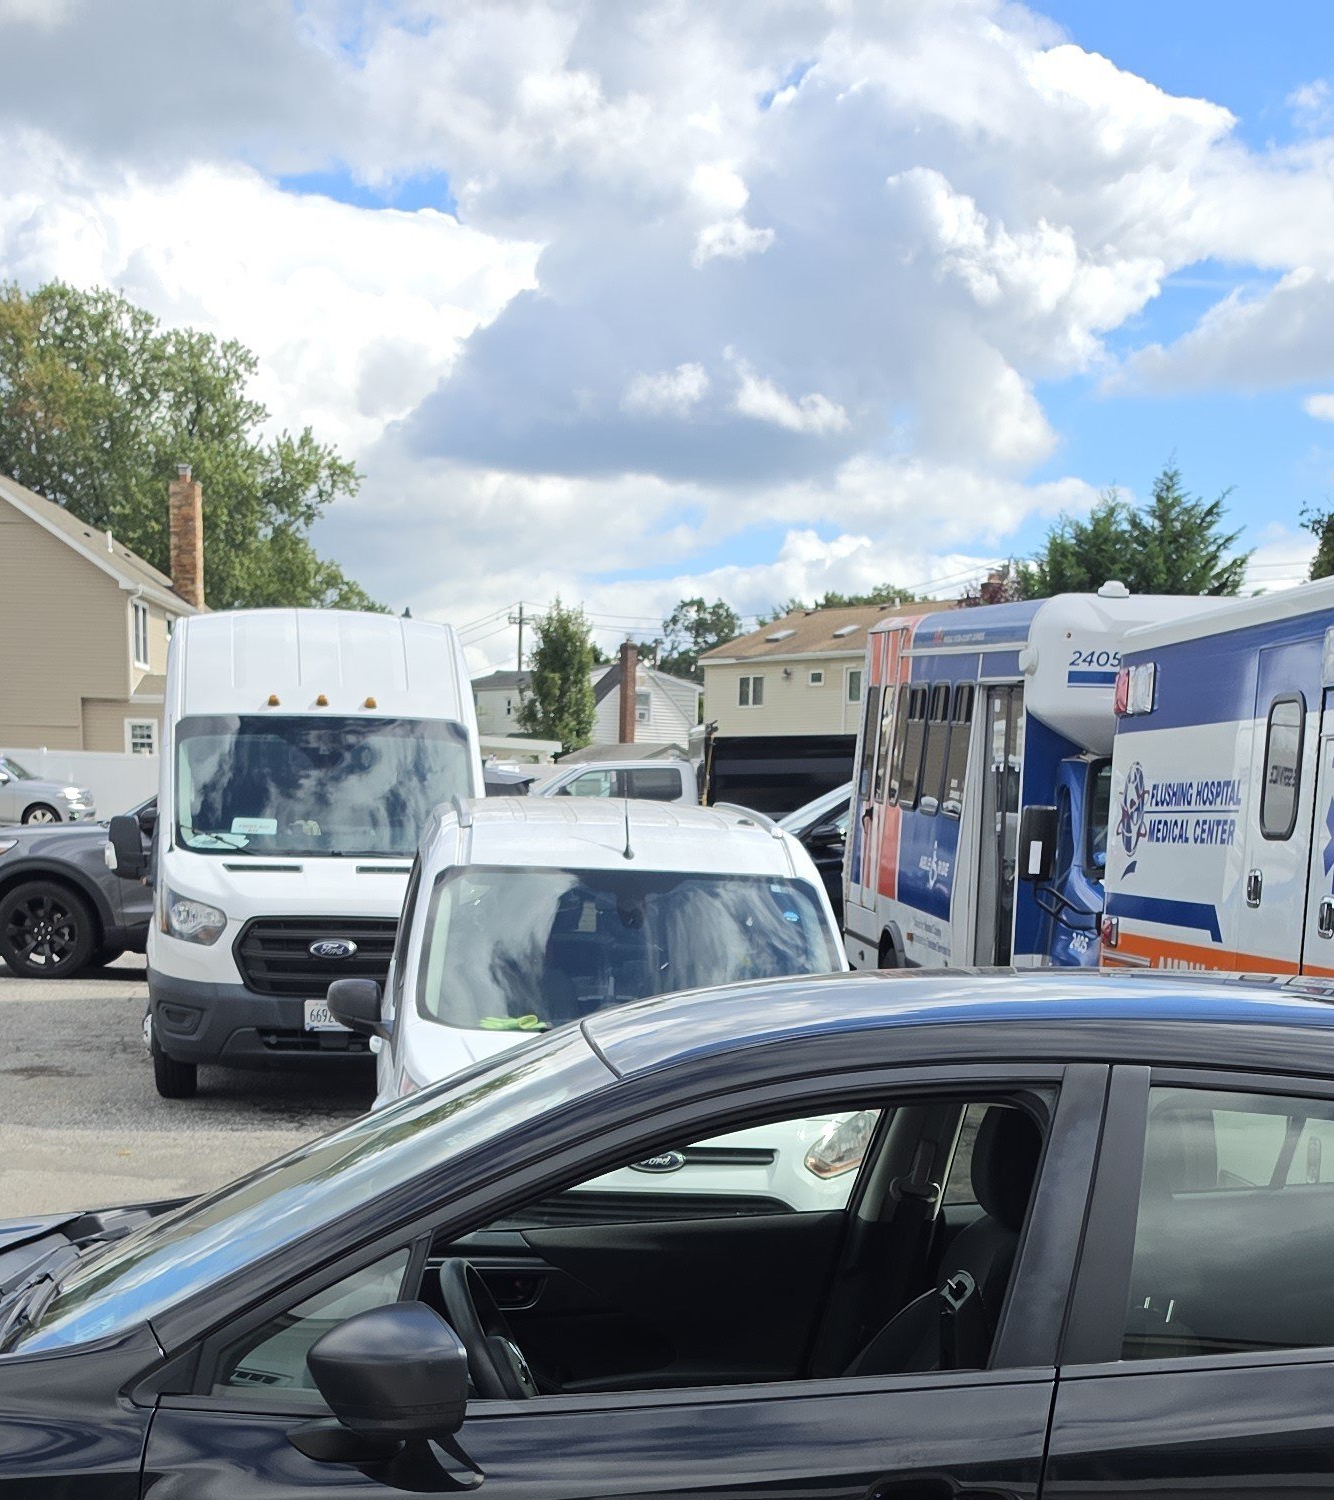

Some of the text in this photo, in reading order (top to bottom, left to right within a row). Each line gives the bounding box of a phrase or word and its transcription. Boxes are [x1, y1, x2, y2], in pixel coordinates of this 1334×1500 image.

[1069, 650, 1121, 667] 2405
[1149, 780, 1241, 807] FLUSHING HOSPITAL
[1148, 819, 1236, 846] MEDICAL CENTER
[320, 943, 345, 955] Ford
